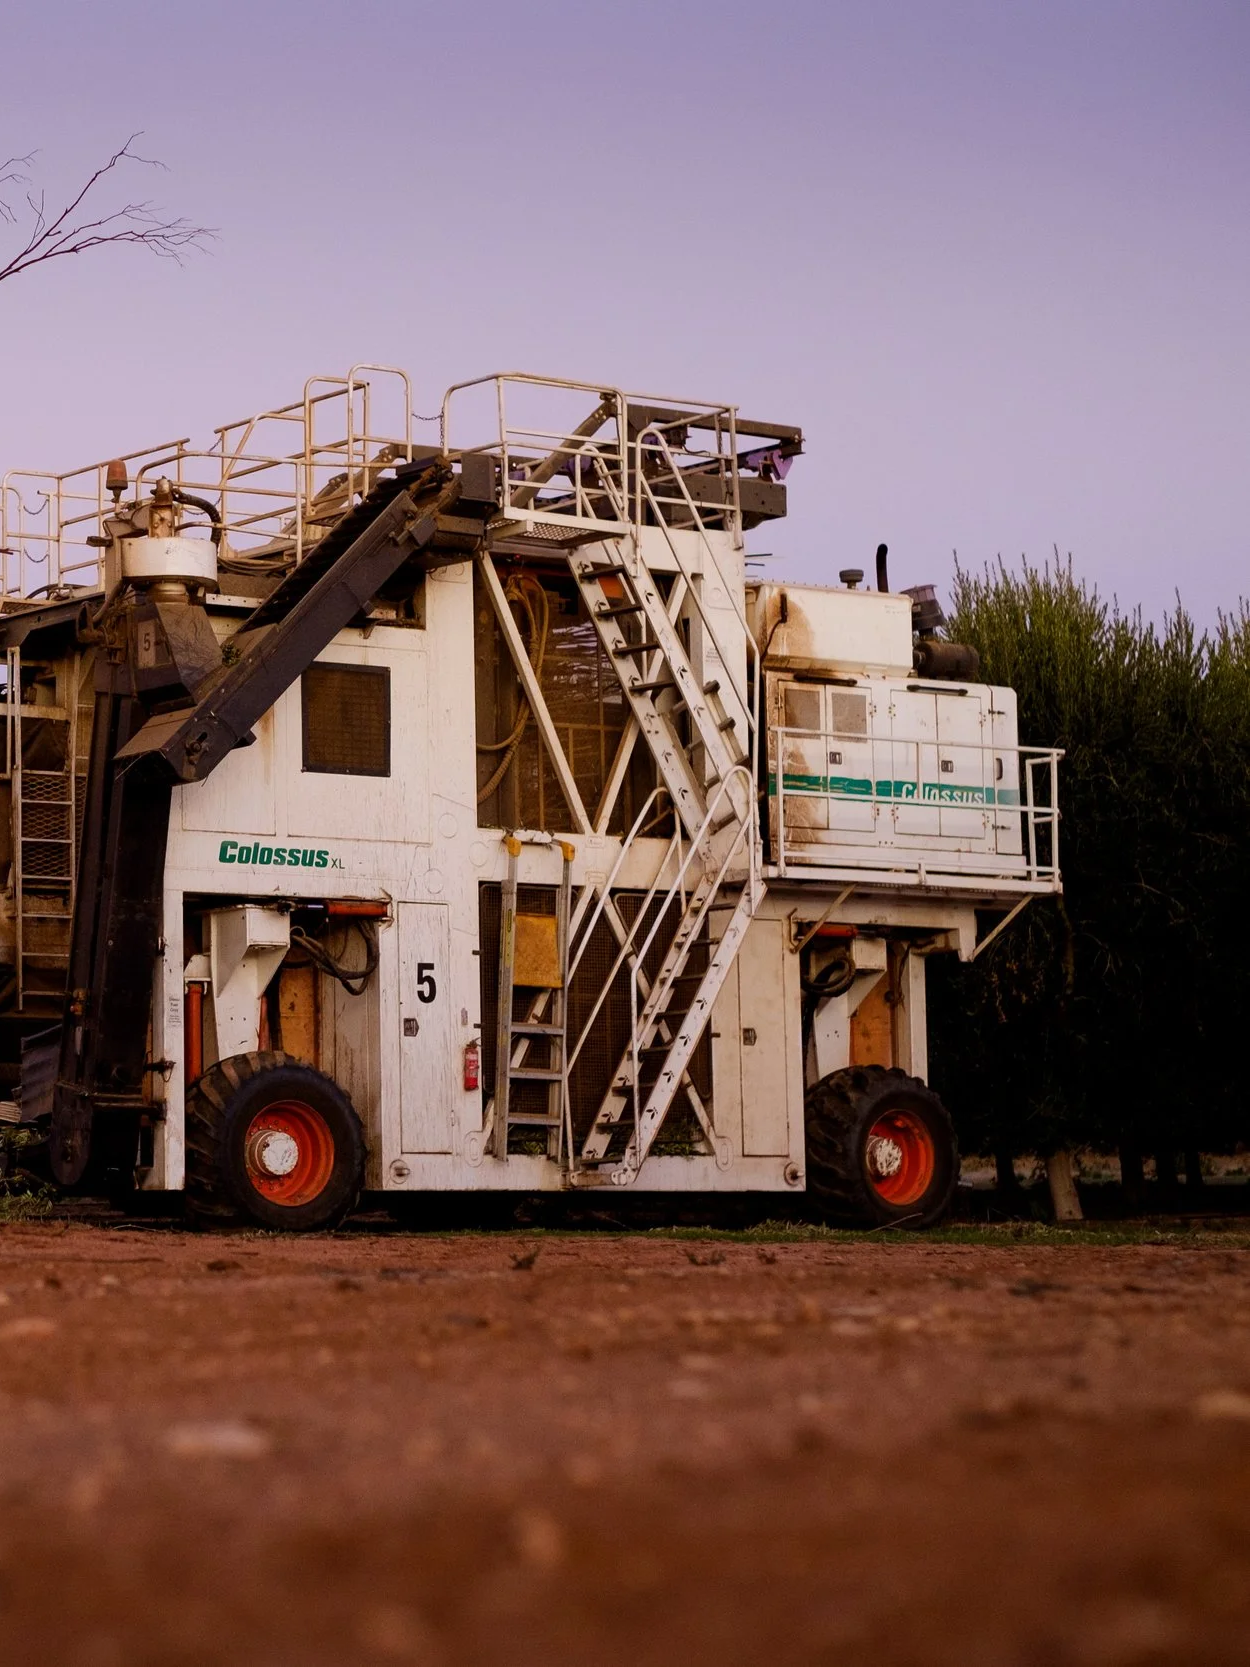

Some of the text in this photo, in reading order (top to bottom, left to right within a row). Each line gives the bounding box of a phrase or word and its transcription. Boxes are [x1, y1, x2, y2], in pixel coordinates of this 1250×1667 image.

[143, 633, 151, 652] 5
[218, 840, 345, 869] Colossus XL
[417, 962, 437, 1003] 5
